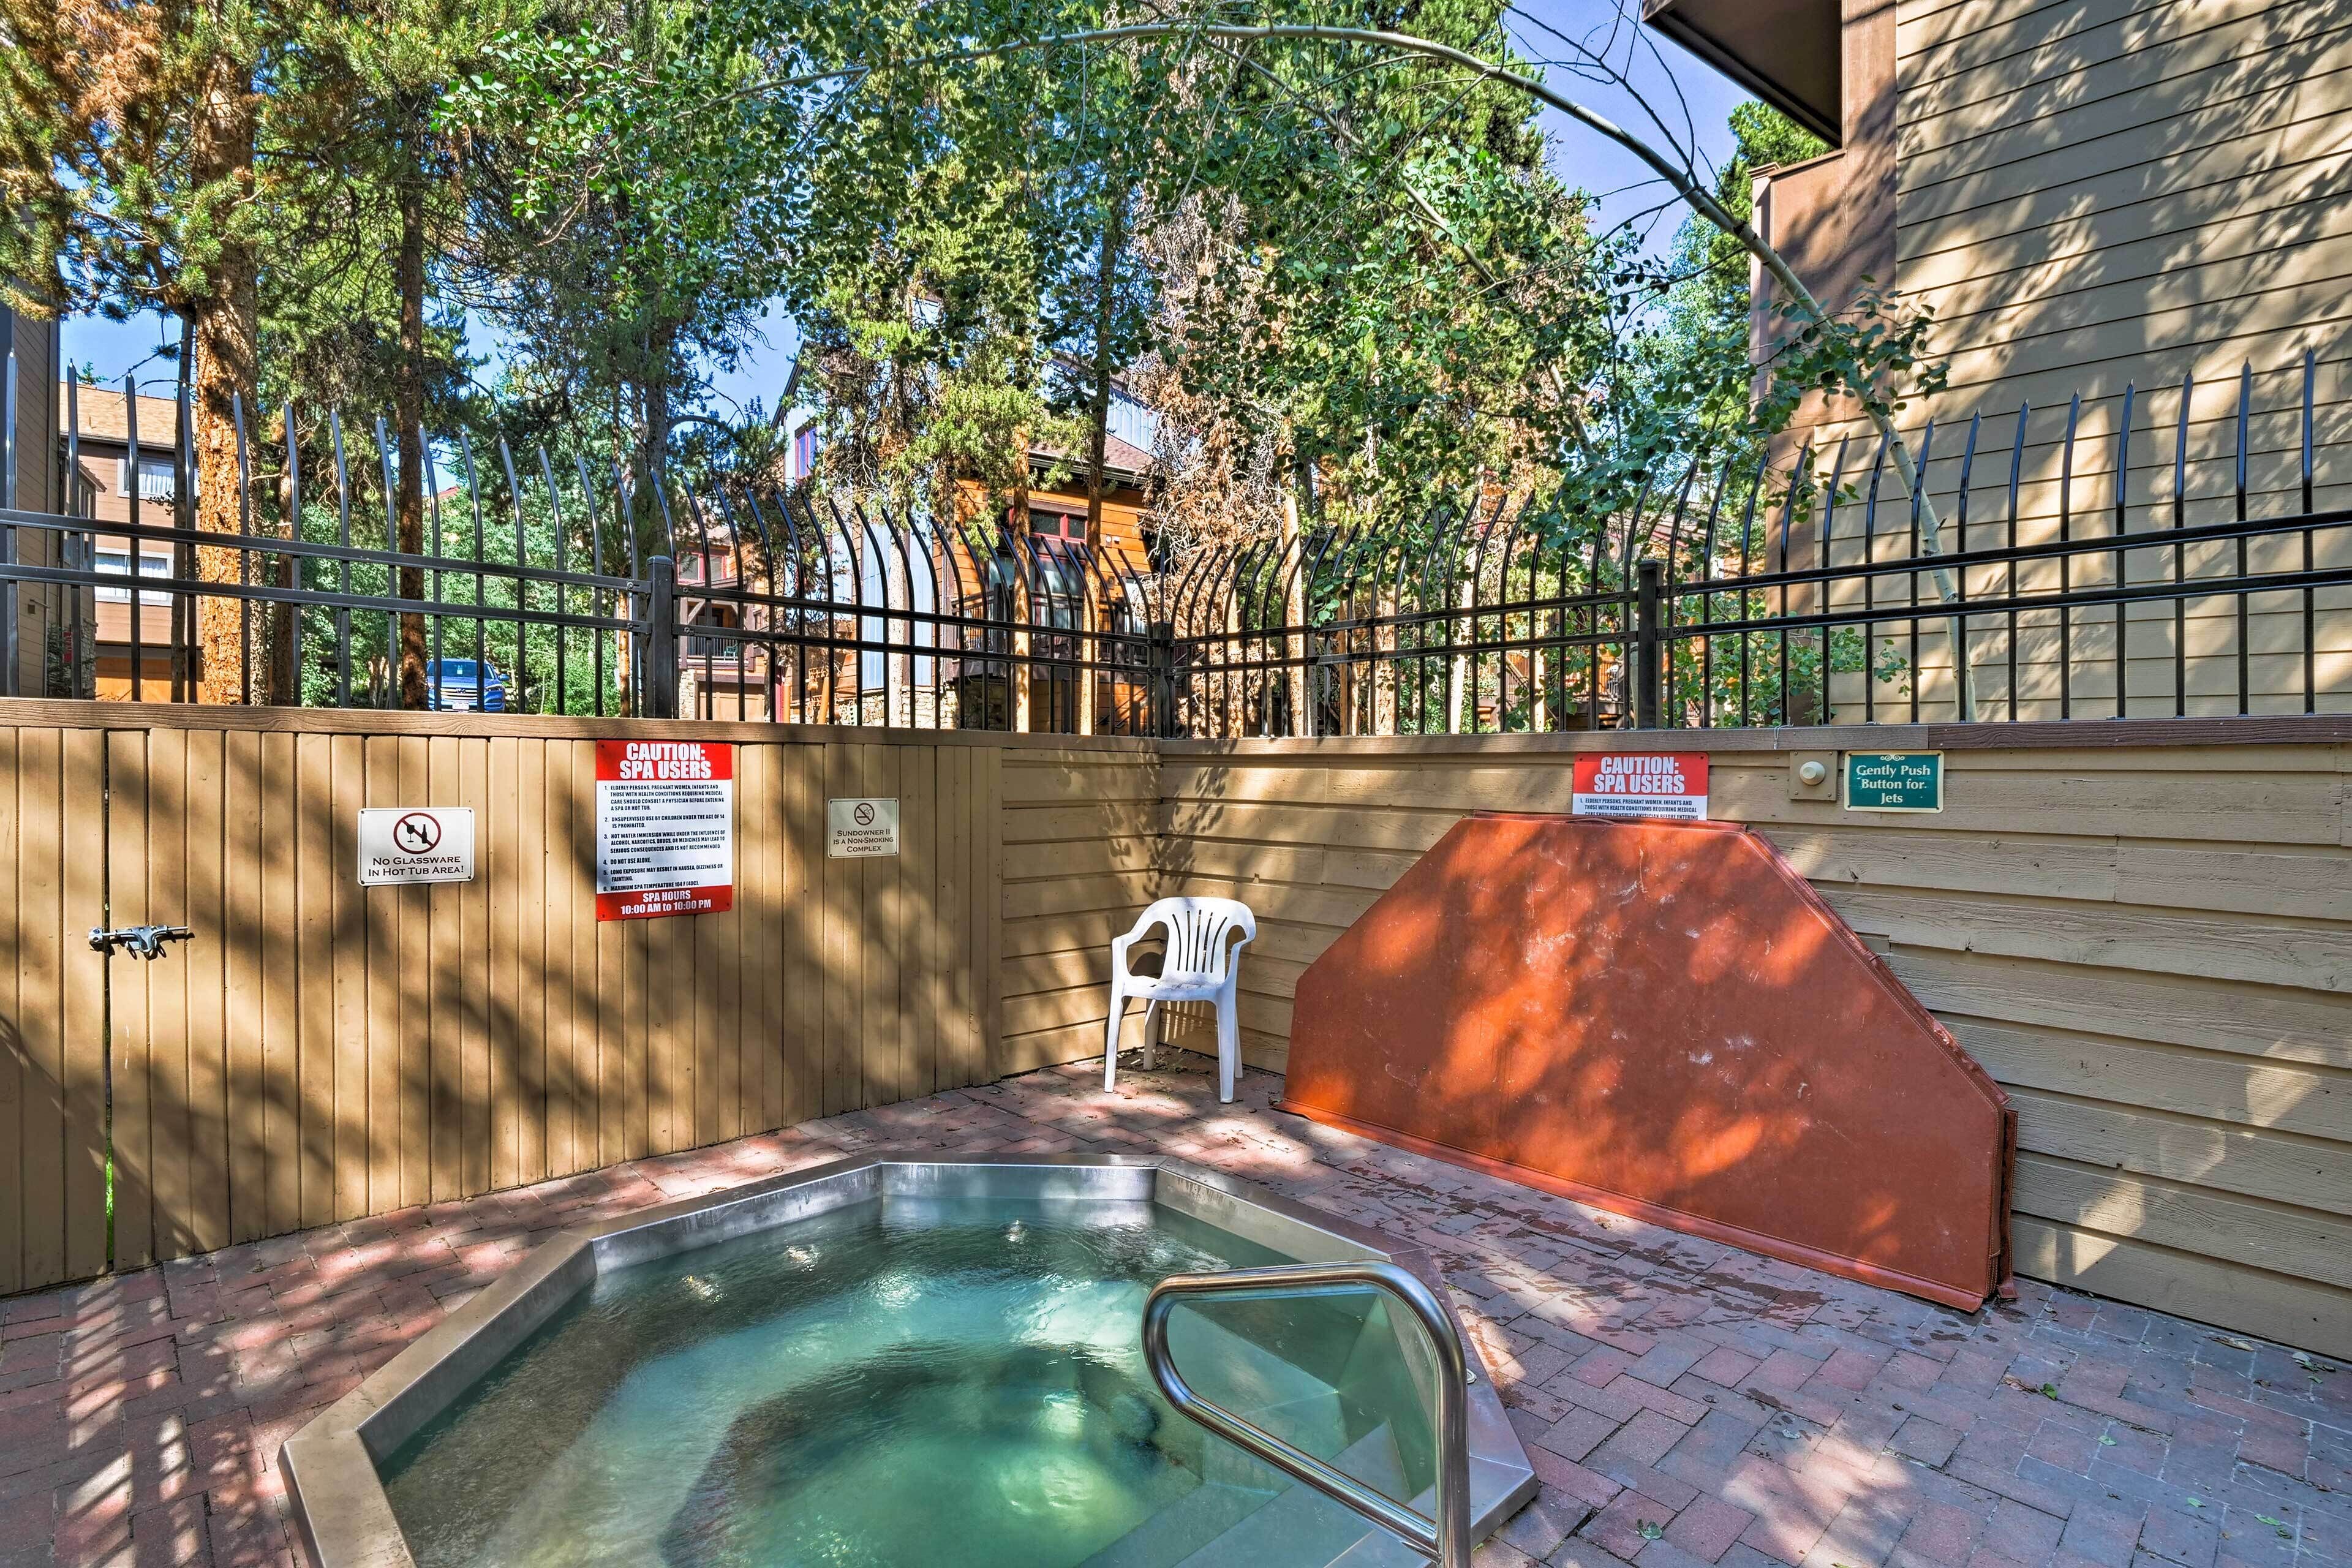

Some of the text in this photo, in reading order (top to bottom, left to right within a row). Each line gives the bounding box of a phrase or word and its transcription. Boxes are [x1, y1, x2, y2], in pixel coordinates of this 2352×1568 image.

[627, 743, 706, 761] CAUTION:
[620, 760, 712, 779] SPA USERS
[1601, 756, 1679, 774] CAUTION:
[1856, 765, 1931, 778] Gently Push
[1594, 774, 1685, 794] SPA USERS
[1861, 780, 1902, 790] Button
[1880, 793, 1903, 804] Jets
[643, 890, 691, 903] SPA HOURS
[620, 899, 711, 915] 10:00 AM to 10:00 PM
